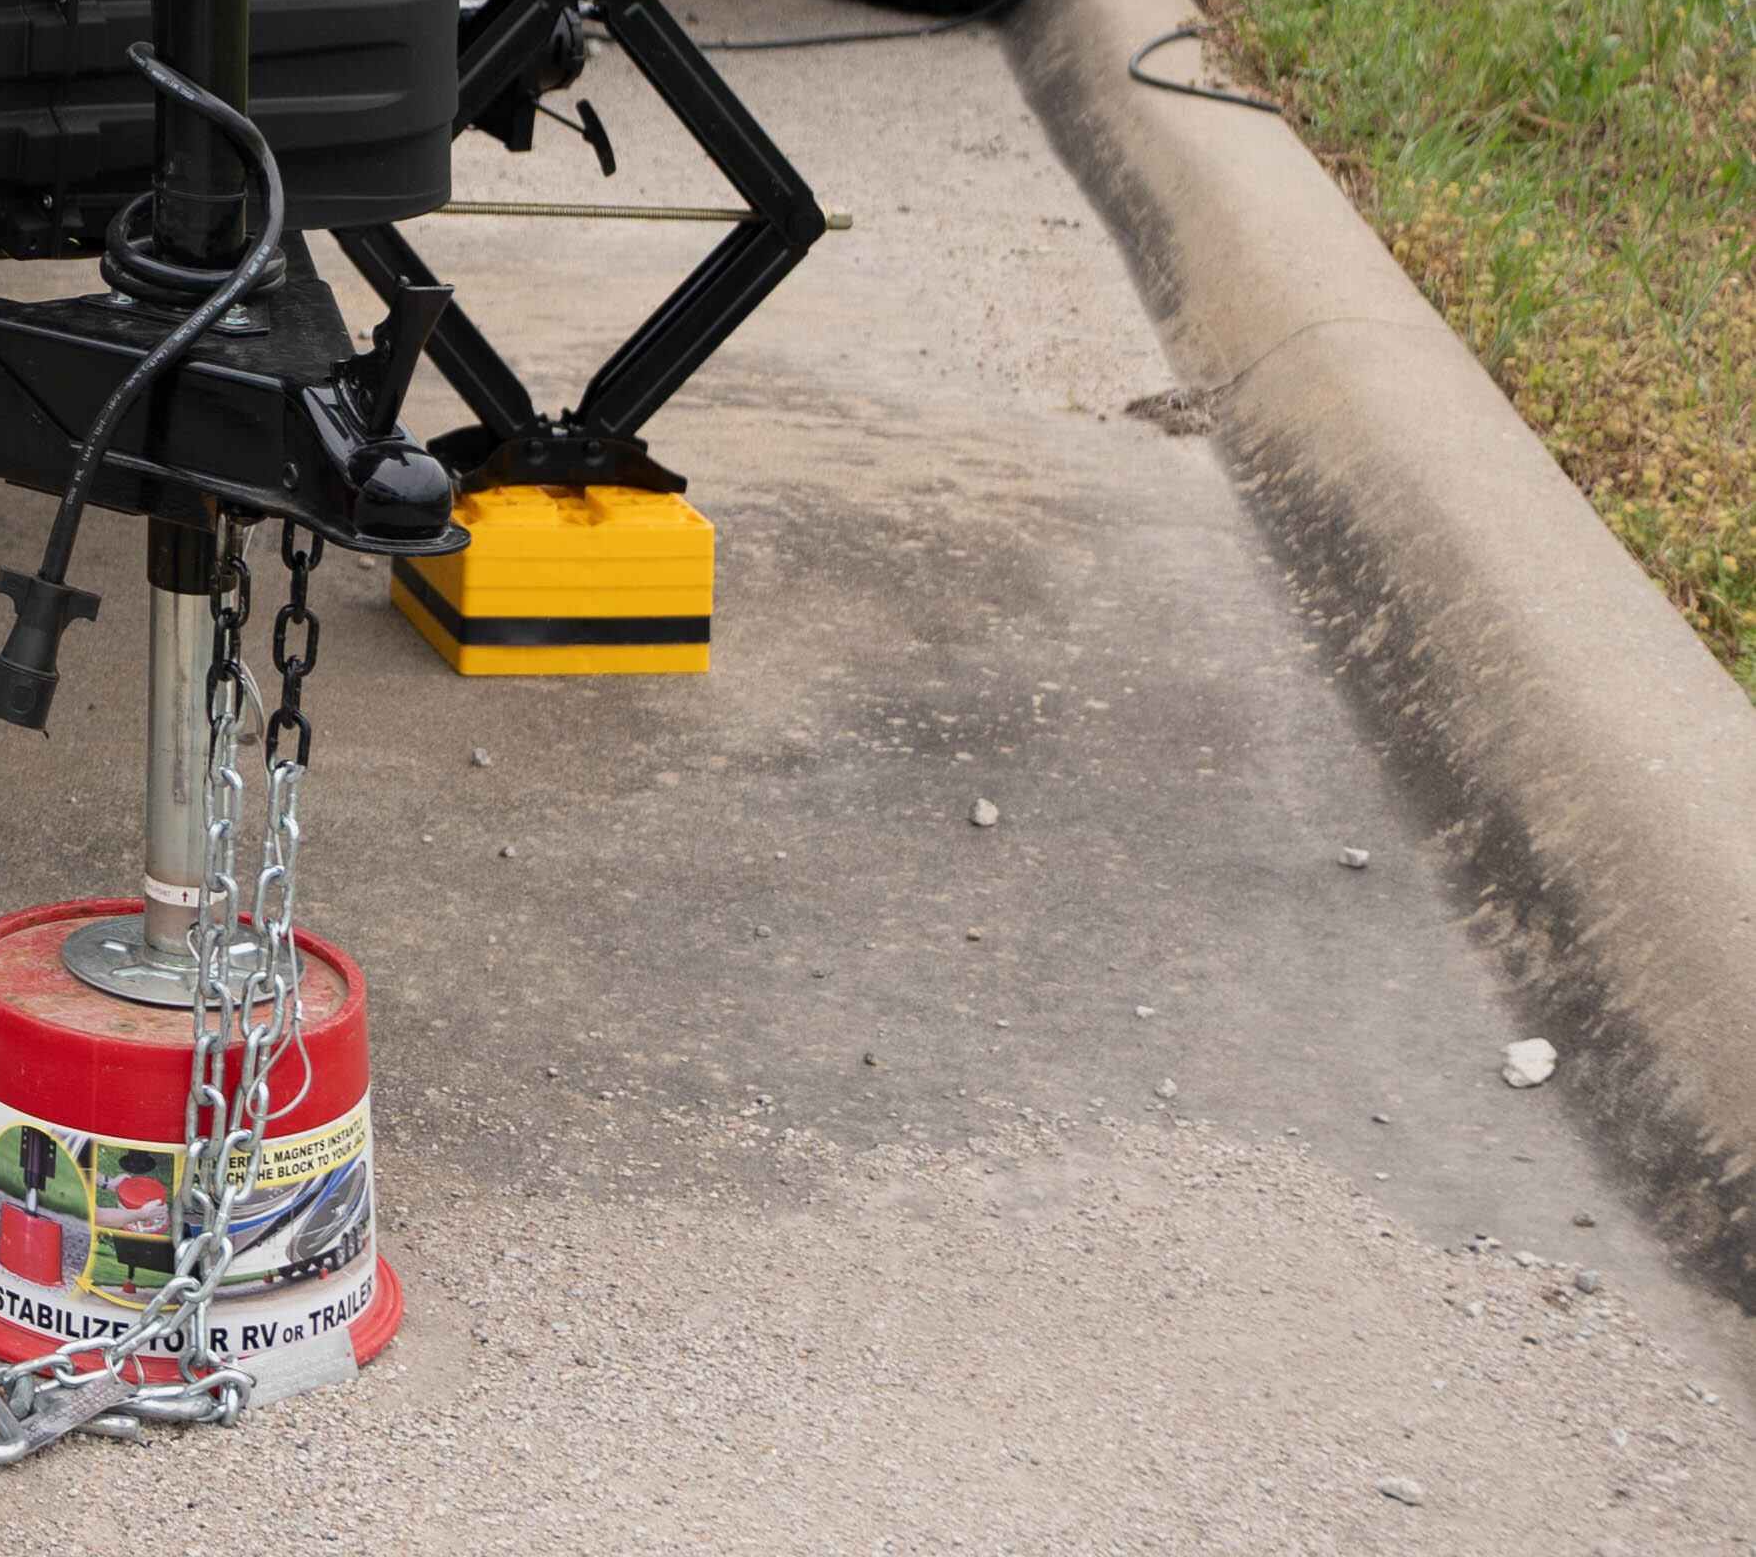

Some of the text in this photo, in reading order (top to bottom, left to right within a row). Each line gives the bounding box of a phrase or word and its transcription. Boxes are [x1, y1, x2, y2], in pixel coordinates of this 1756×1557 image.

[273, 1139, 325, 1164] MAGNETS
[277, 1159, 314, 1179] BLOCK
[317, 1153, 330, 1168] TO
[241, 1322, 278, 1352] RV
[283, 1325, 304, 1344] OR
[308, 1275, 374, 1336] TRAILER
